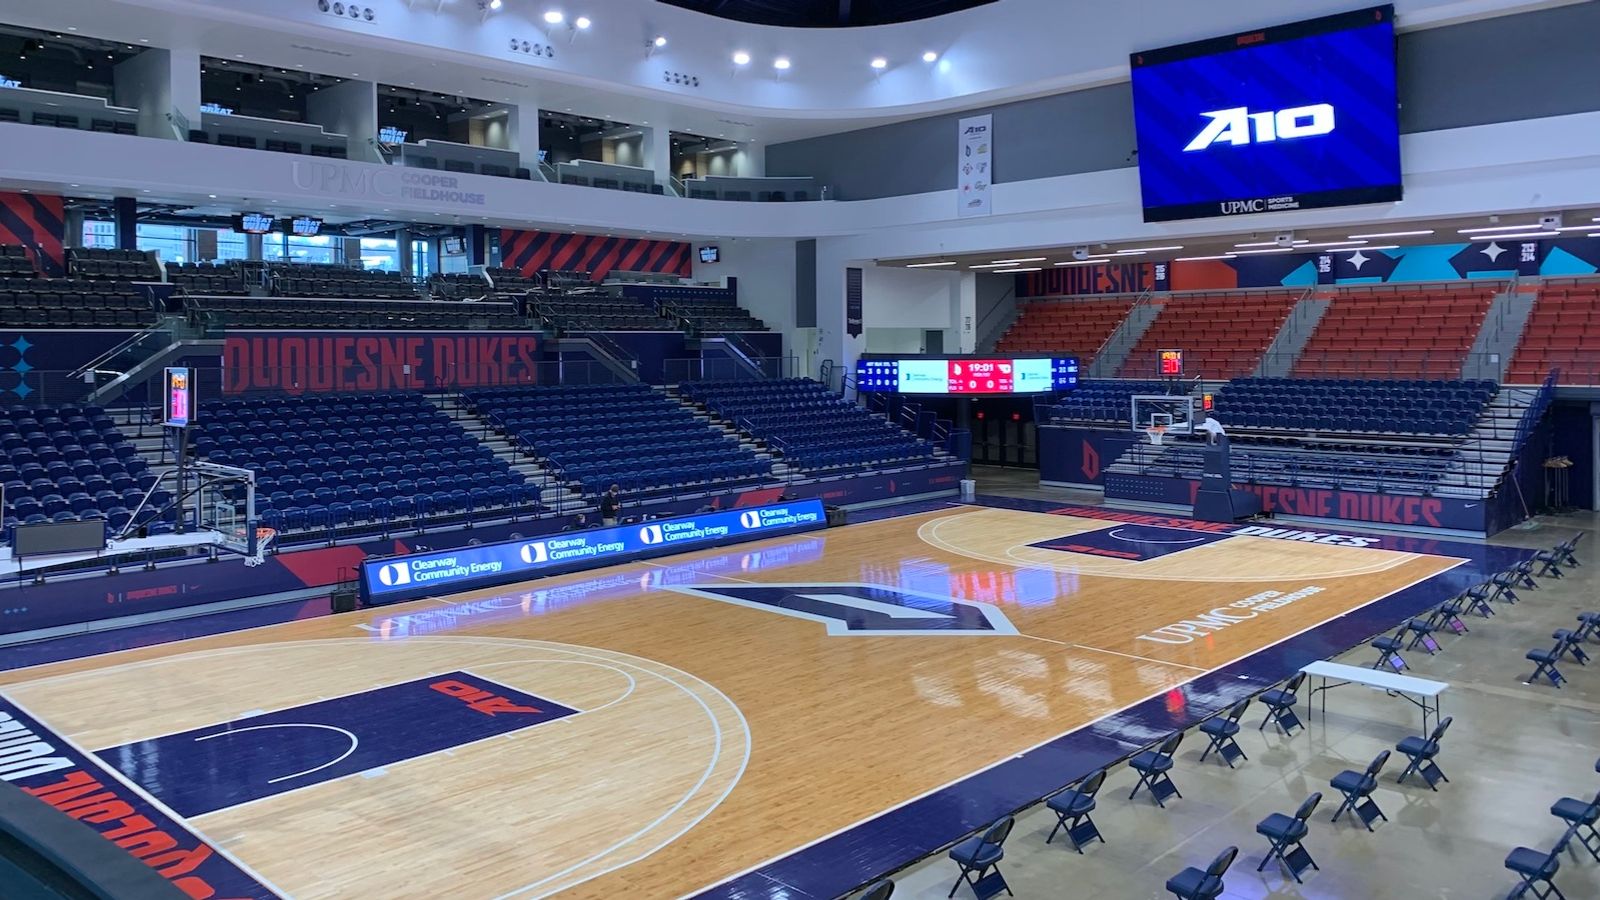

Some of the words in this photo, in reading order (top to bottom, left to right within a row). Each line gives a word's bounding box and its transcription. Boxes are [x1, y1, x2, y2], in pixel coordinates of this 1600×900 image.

[1182, 104, 1336, 152] A10
[291, 160, 396, 197] UPMC
[401, 172, 458, 189] COOPER
[401, 186, 486, 206] FIELDHOUSE
[1220, 199, 1264, 215] UPMC
[223, 337, 425, 395] DUQUESNE
[431, 336, 538, 389] DUKES
[968, 363, 994, 372] 19:01
[760, 507, 789, 520] Clearway
[761, 515, 797, 527] Community
[797, 511, 817, 522] Energy
[663, 520, 696, 533] Clearway
[664, 529, 705, 542] Community
[705, 525, 729, 537] Energy
[547, 536, 586, 550] Clearway
[1229, 524, 1381, 548] DUKES
[549, 544, 599, 561] Community
[598, 541, 625, 553] Energy
[411, 556, 457, 571] Clearway
[413, 565, 470, 583] Community
[470, 560, 502, 574] Energy
[1136, 606, 1259, 645] UPMC
